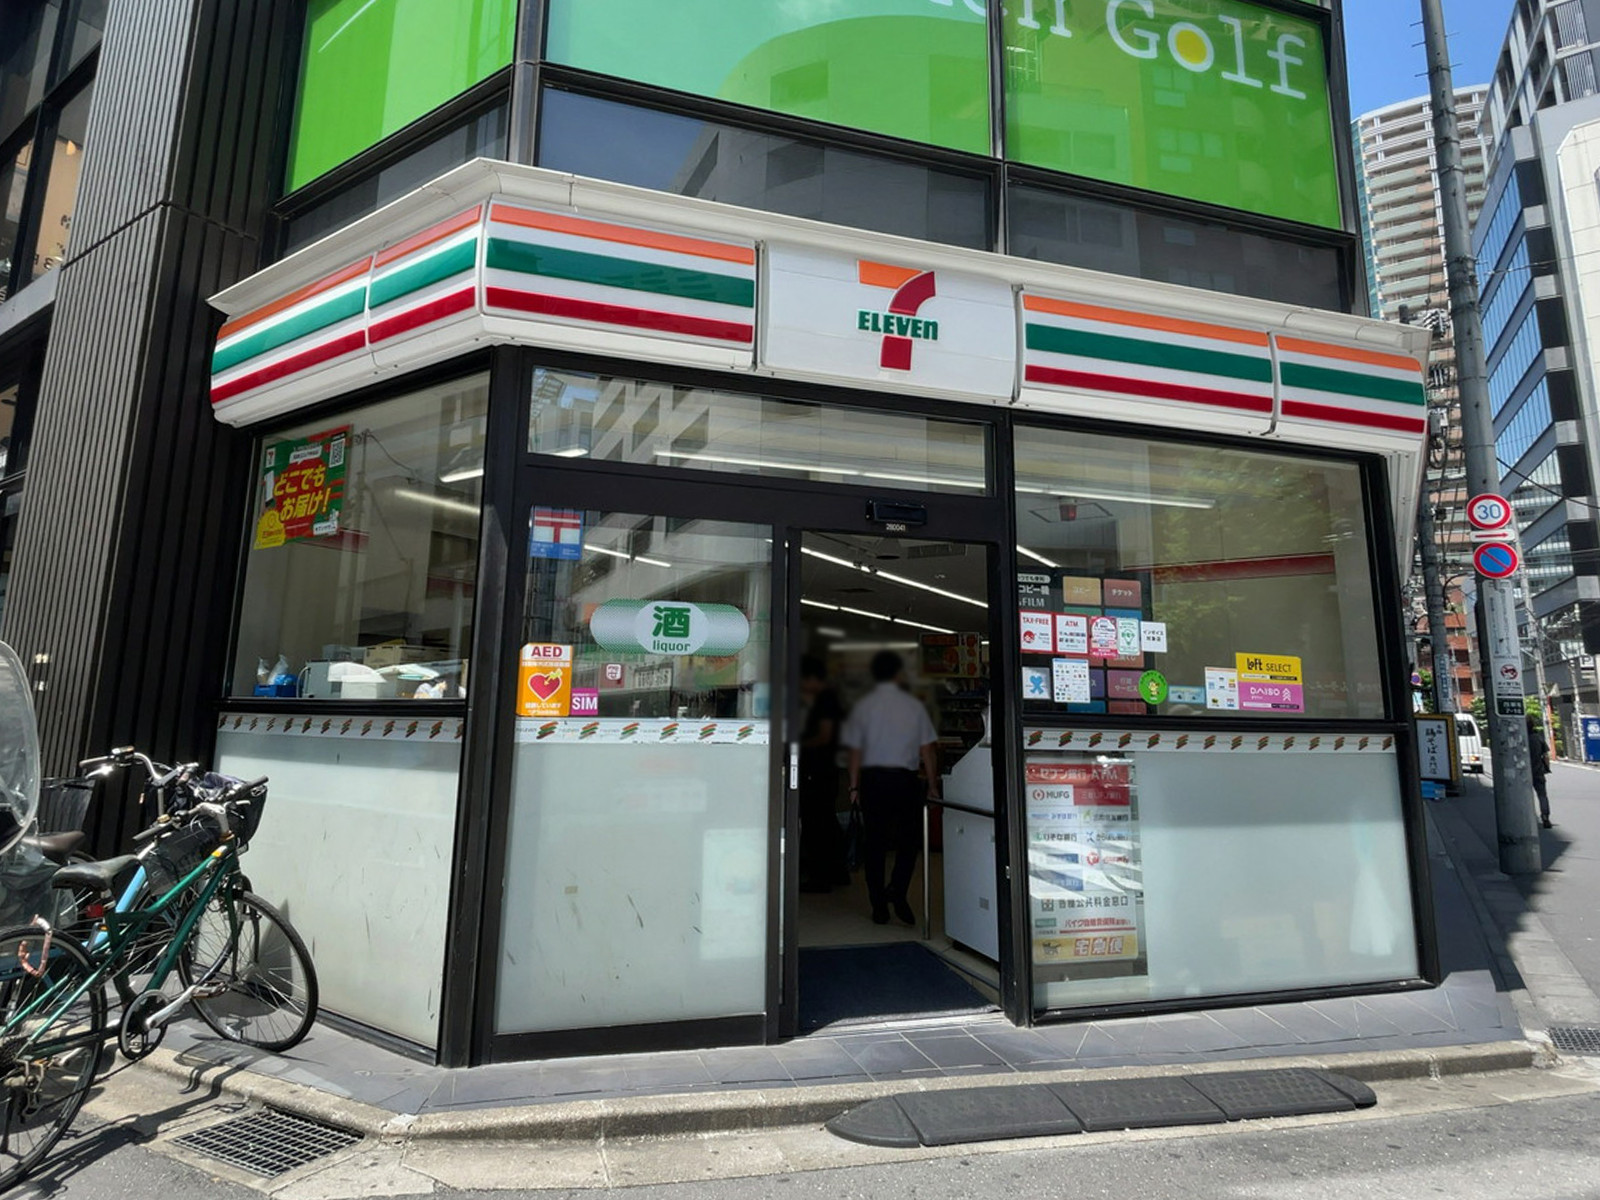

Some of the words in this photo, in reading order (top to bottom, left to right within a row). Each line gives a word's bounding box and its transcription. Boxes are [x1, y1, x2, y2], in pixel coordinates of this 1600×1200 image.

[1106, 0, 1306, 100] Golf
[273, 465, 326, 496] どこでも
[1477, 503, 1501, 520] 30
[652, 605, 691, 638] 酒
[531, 646, 563, 658] AED
[652, 640, 691, 653] liquor
[1265, 662, 1292, 673] SELECT
[1249, 686, 1281, 696] DAISO
[571, 696, 599, 711] SIM
[1091, 768, 1118, 780] ATM
[1046, 790, 1070, 799] MUFG
